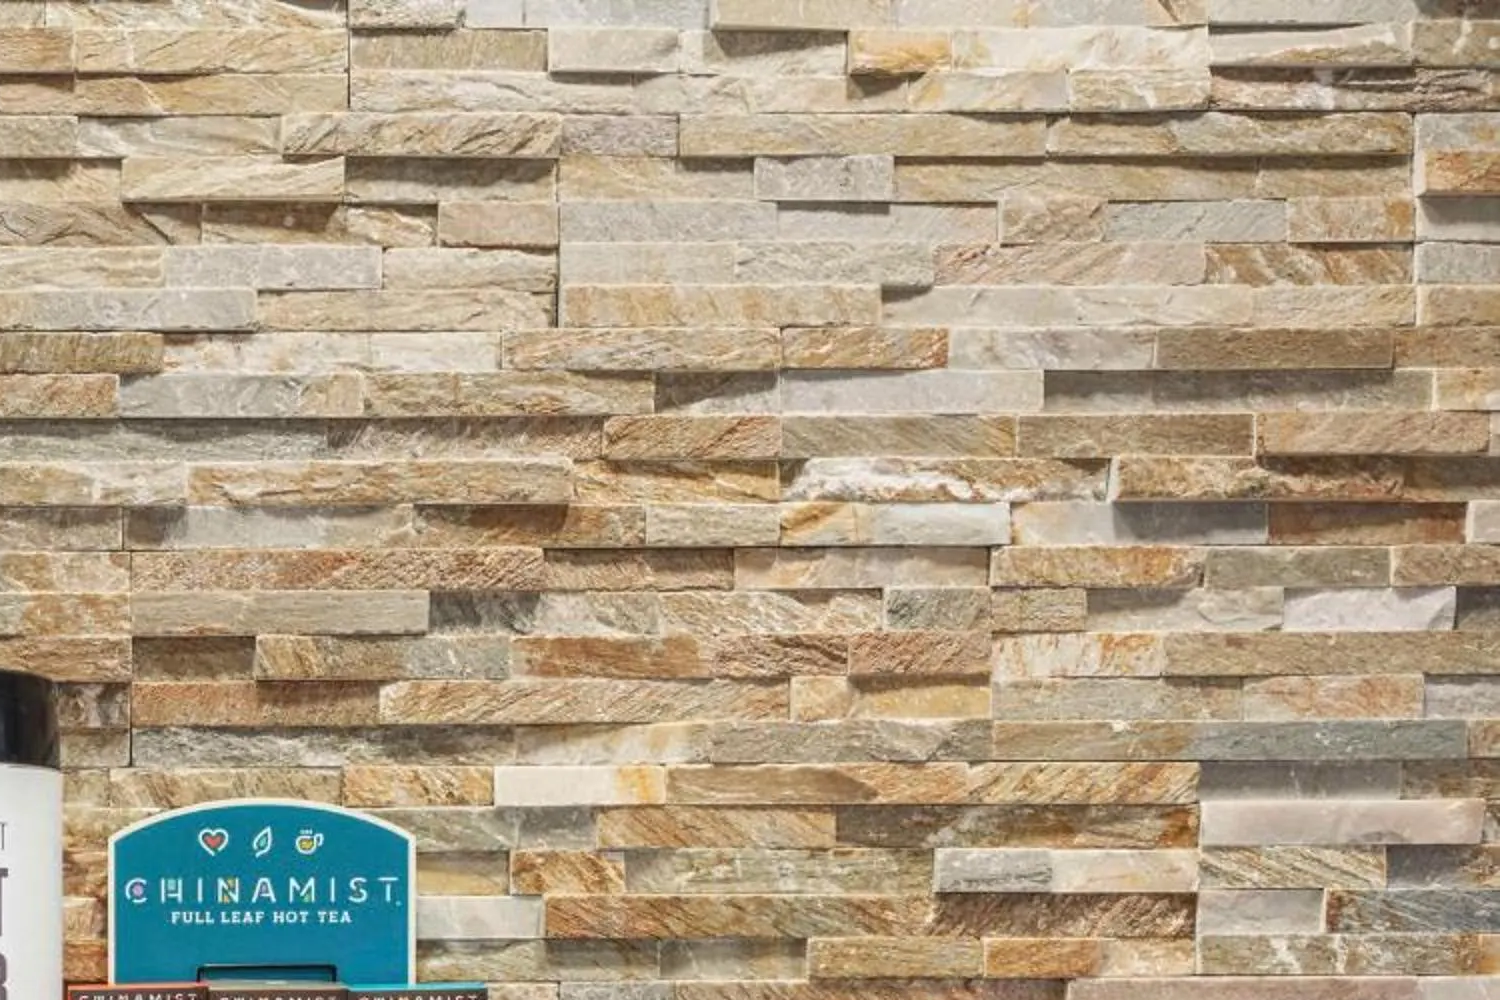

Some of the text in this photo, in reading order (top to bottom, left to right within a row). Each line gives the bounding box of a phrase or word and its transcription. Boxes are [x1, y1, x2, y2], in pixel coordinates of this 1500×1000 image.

[171, 911, 352, 924] FULL LEAF HOT TEA
